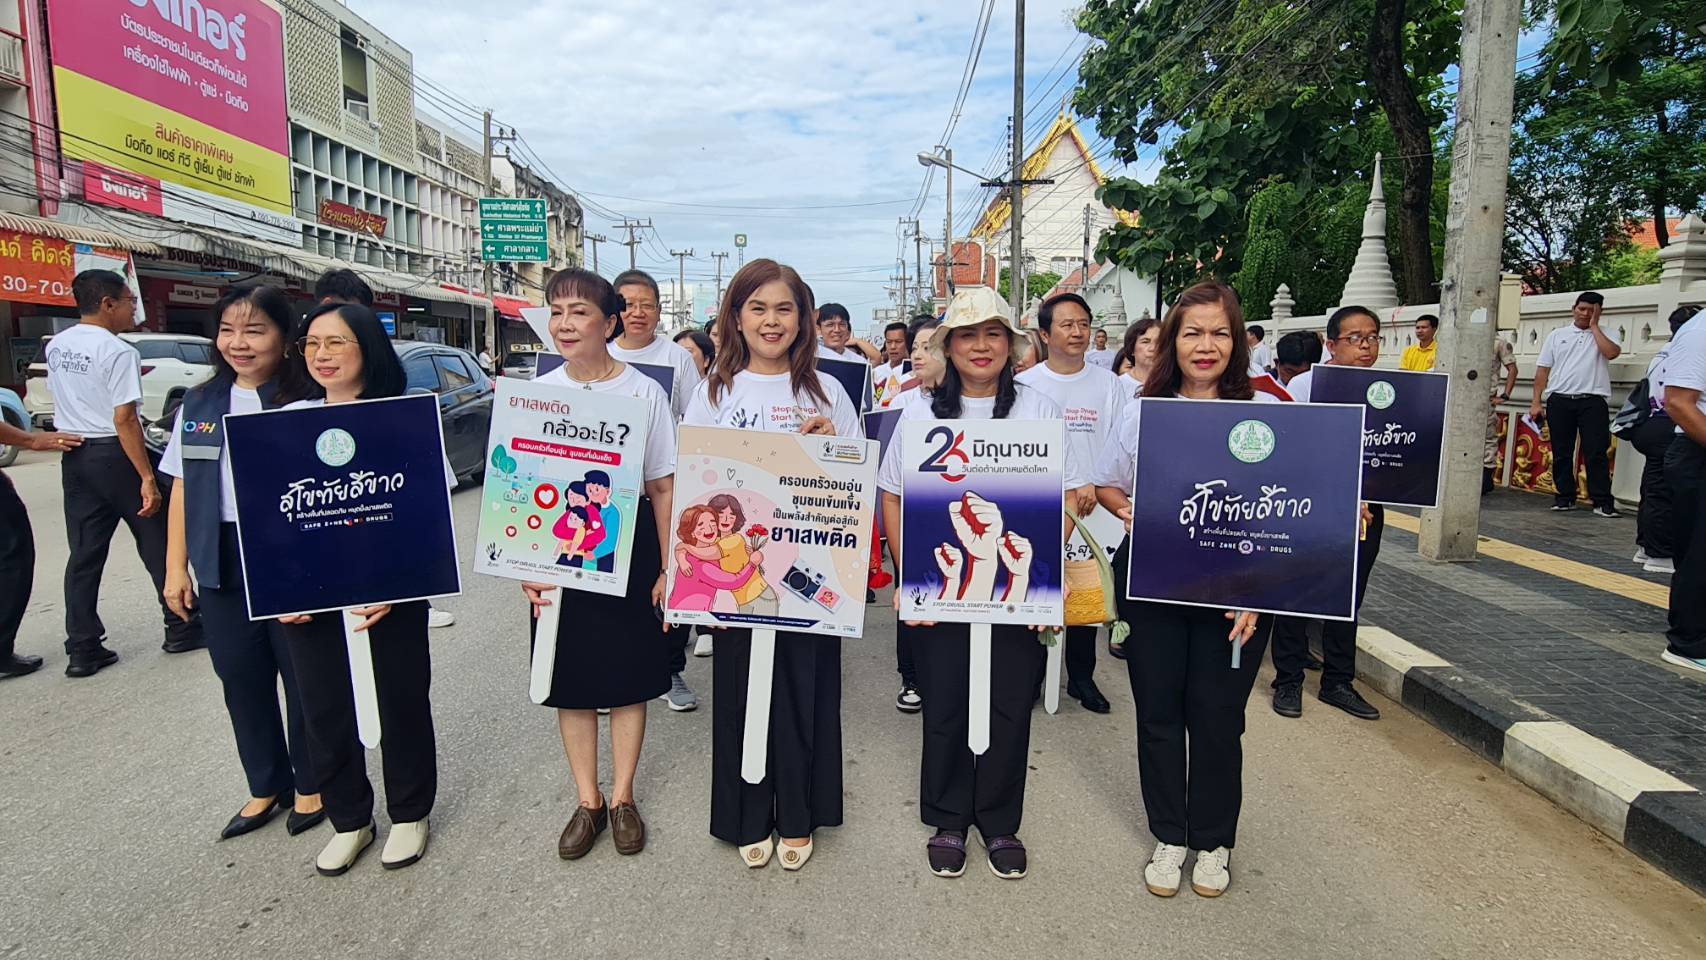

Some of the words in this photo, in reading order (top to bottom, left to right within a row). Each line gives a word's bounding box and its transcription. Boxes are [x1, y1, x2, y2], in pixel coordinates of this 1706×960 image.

[123, 45, 191, 86] เครื่องใช้ไฟฟ้า
[225, 91, 249, 112] มือถือ
[155, 122, 234, 164] สินค้าราคาพิเศษ
[125, 134, 153, 155] มือถือ
[156, 147, 175, 162] แอร์
[178, 152, 191, 168] ทีวี
[194, 158, 214, 175] ตู้เย็น
[216, 165, 232, 181] ตู้แช่
[234, 171, 255, 188] ซักผ้า
[31, 239, 74, 267] คิดส์
[503, 245, 539, 253] ศาลากลาง
[509, 396, 571, 415] ยาเสพติด
[772, 406, 792, 414] Stop
[182, 420, 216, 433] OPH
[543, 419, 630, 446] กลัวอะไร?
[918, 425, 970, 482] 26
[973, 439, 1048, 463] มิถุนายน
[961, 464, 1048, 473] วันต่อต้านยาเสพติดโลก
[779, 475, 862, 493] ครอบครัวอบอุ่น
[279, 470, 404, 522] สุโขทัยสีขาว
[792, 492, 860, 510] ชุมชนเข้มแข็ง
[772, 508, 859, 528] เป็นพลังสำคัญต่อสู้กับ
[1179, 479, 1311, 539] สุโขทัยสีขาว
[771, 527, 857, 549] ยาเสพติด
[1199, 540, 1215, 548] SAFE
[1270, 545, 1293, 553] DRUGS
